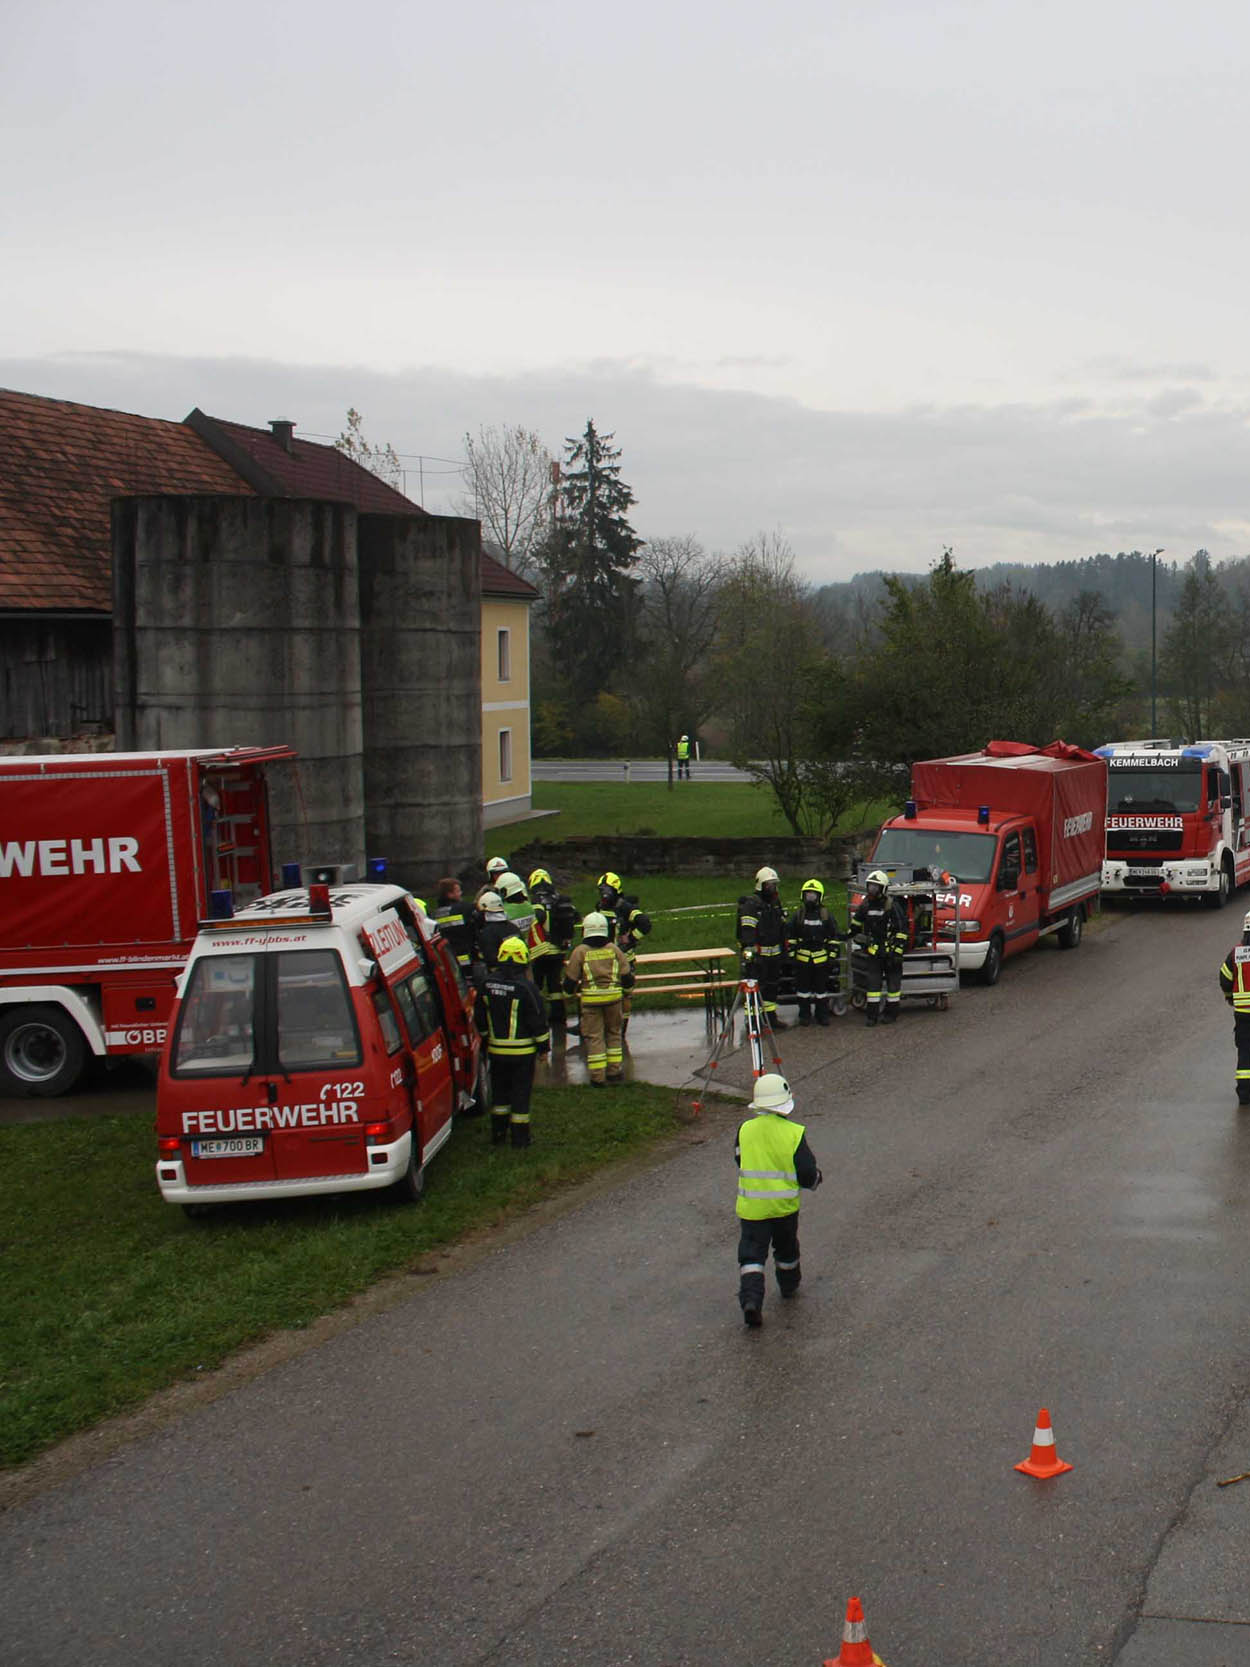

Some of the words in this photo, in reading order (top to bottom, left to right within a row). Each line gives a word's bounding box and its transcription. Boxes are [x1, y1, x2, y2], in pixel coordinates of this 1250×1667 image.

[1109, 758, 1179, 767] KEMMELBACH
[1104, 817, 1183, 828] FEUERWEHR
[0, 836, 143, 878] WEHR
[212, 935, 308, 948] www.ff-ybbs.at
[333, 1081, 366, 1098] 122
[182, 1101, 359, 1134] FEUERWEHR
[223, 1139, 243, 1152] 700
[245, 1138, 259, 1151] BR
